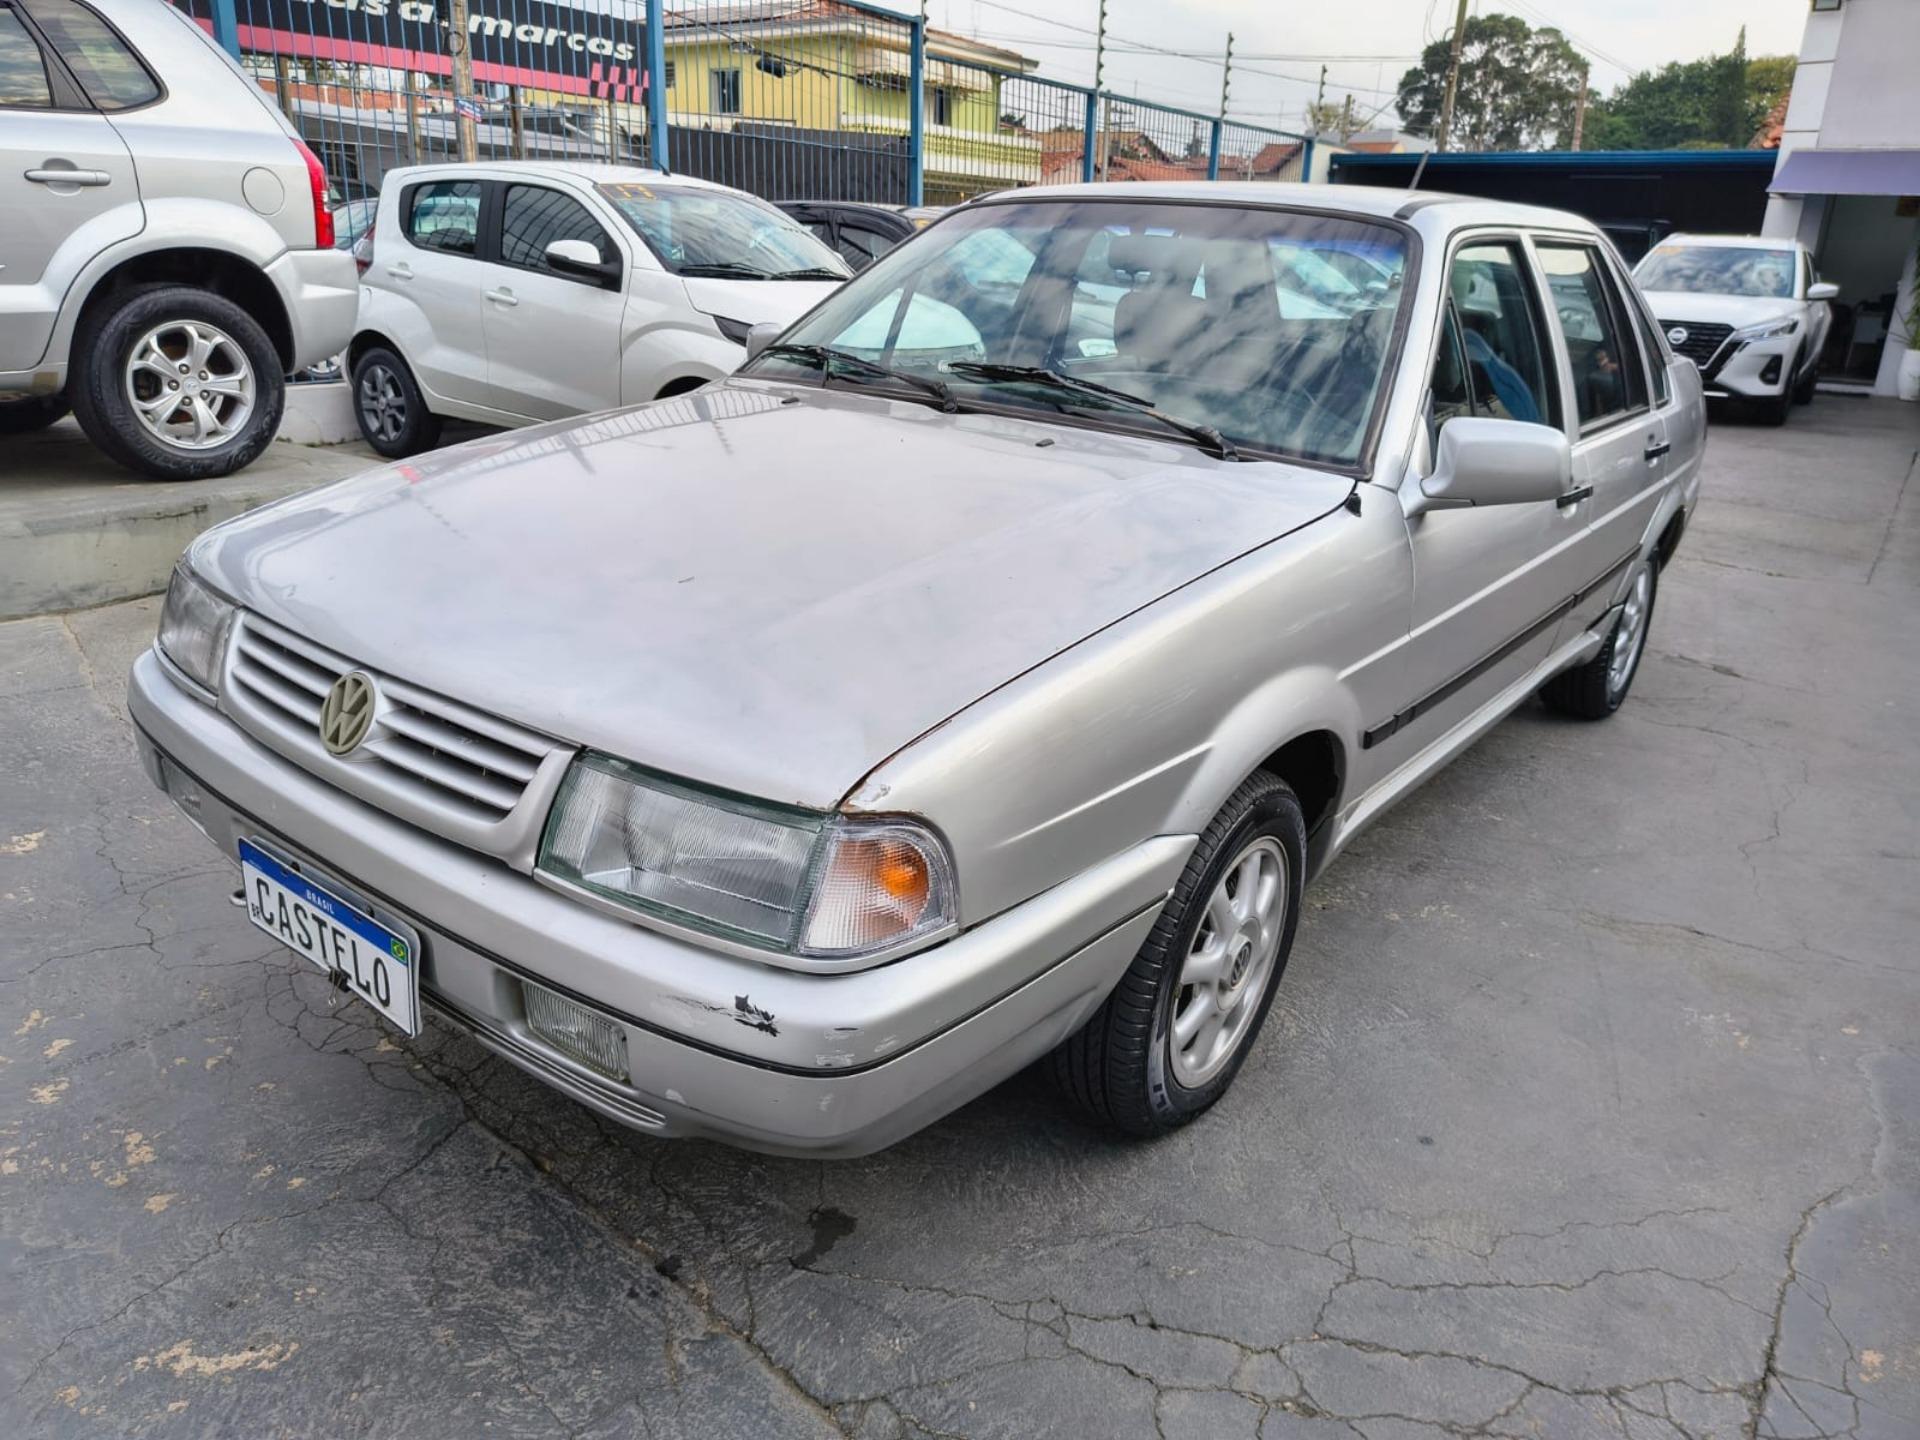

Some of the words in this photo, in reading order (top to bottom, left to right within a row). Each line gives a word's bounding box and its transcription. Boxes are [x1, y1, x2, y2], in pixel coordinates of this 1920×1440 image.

[468, 14, 635, 61] marcas
[305, 889, 335, 915] BRASIL
[256, 877, 391, 1008] CASTELO
